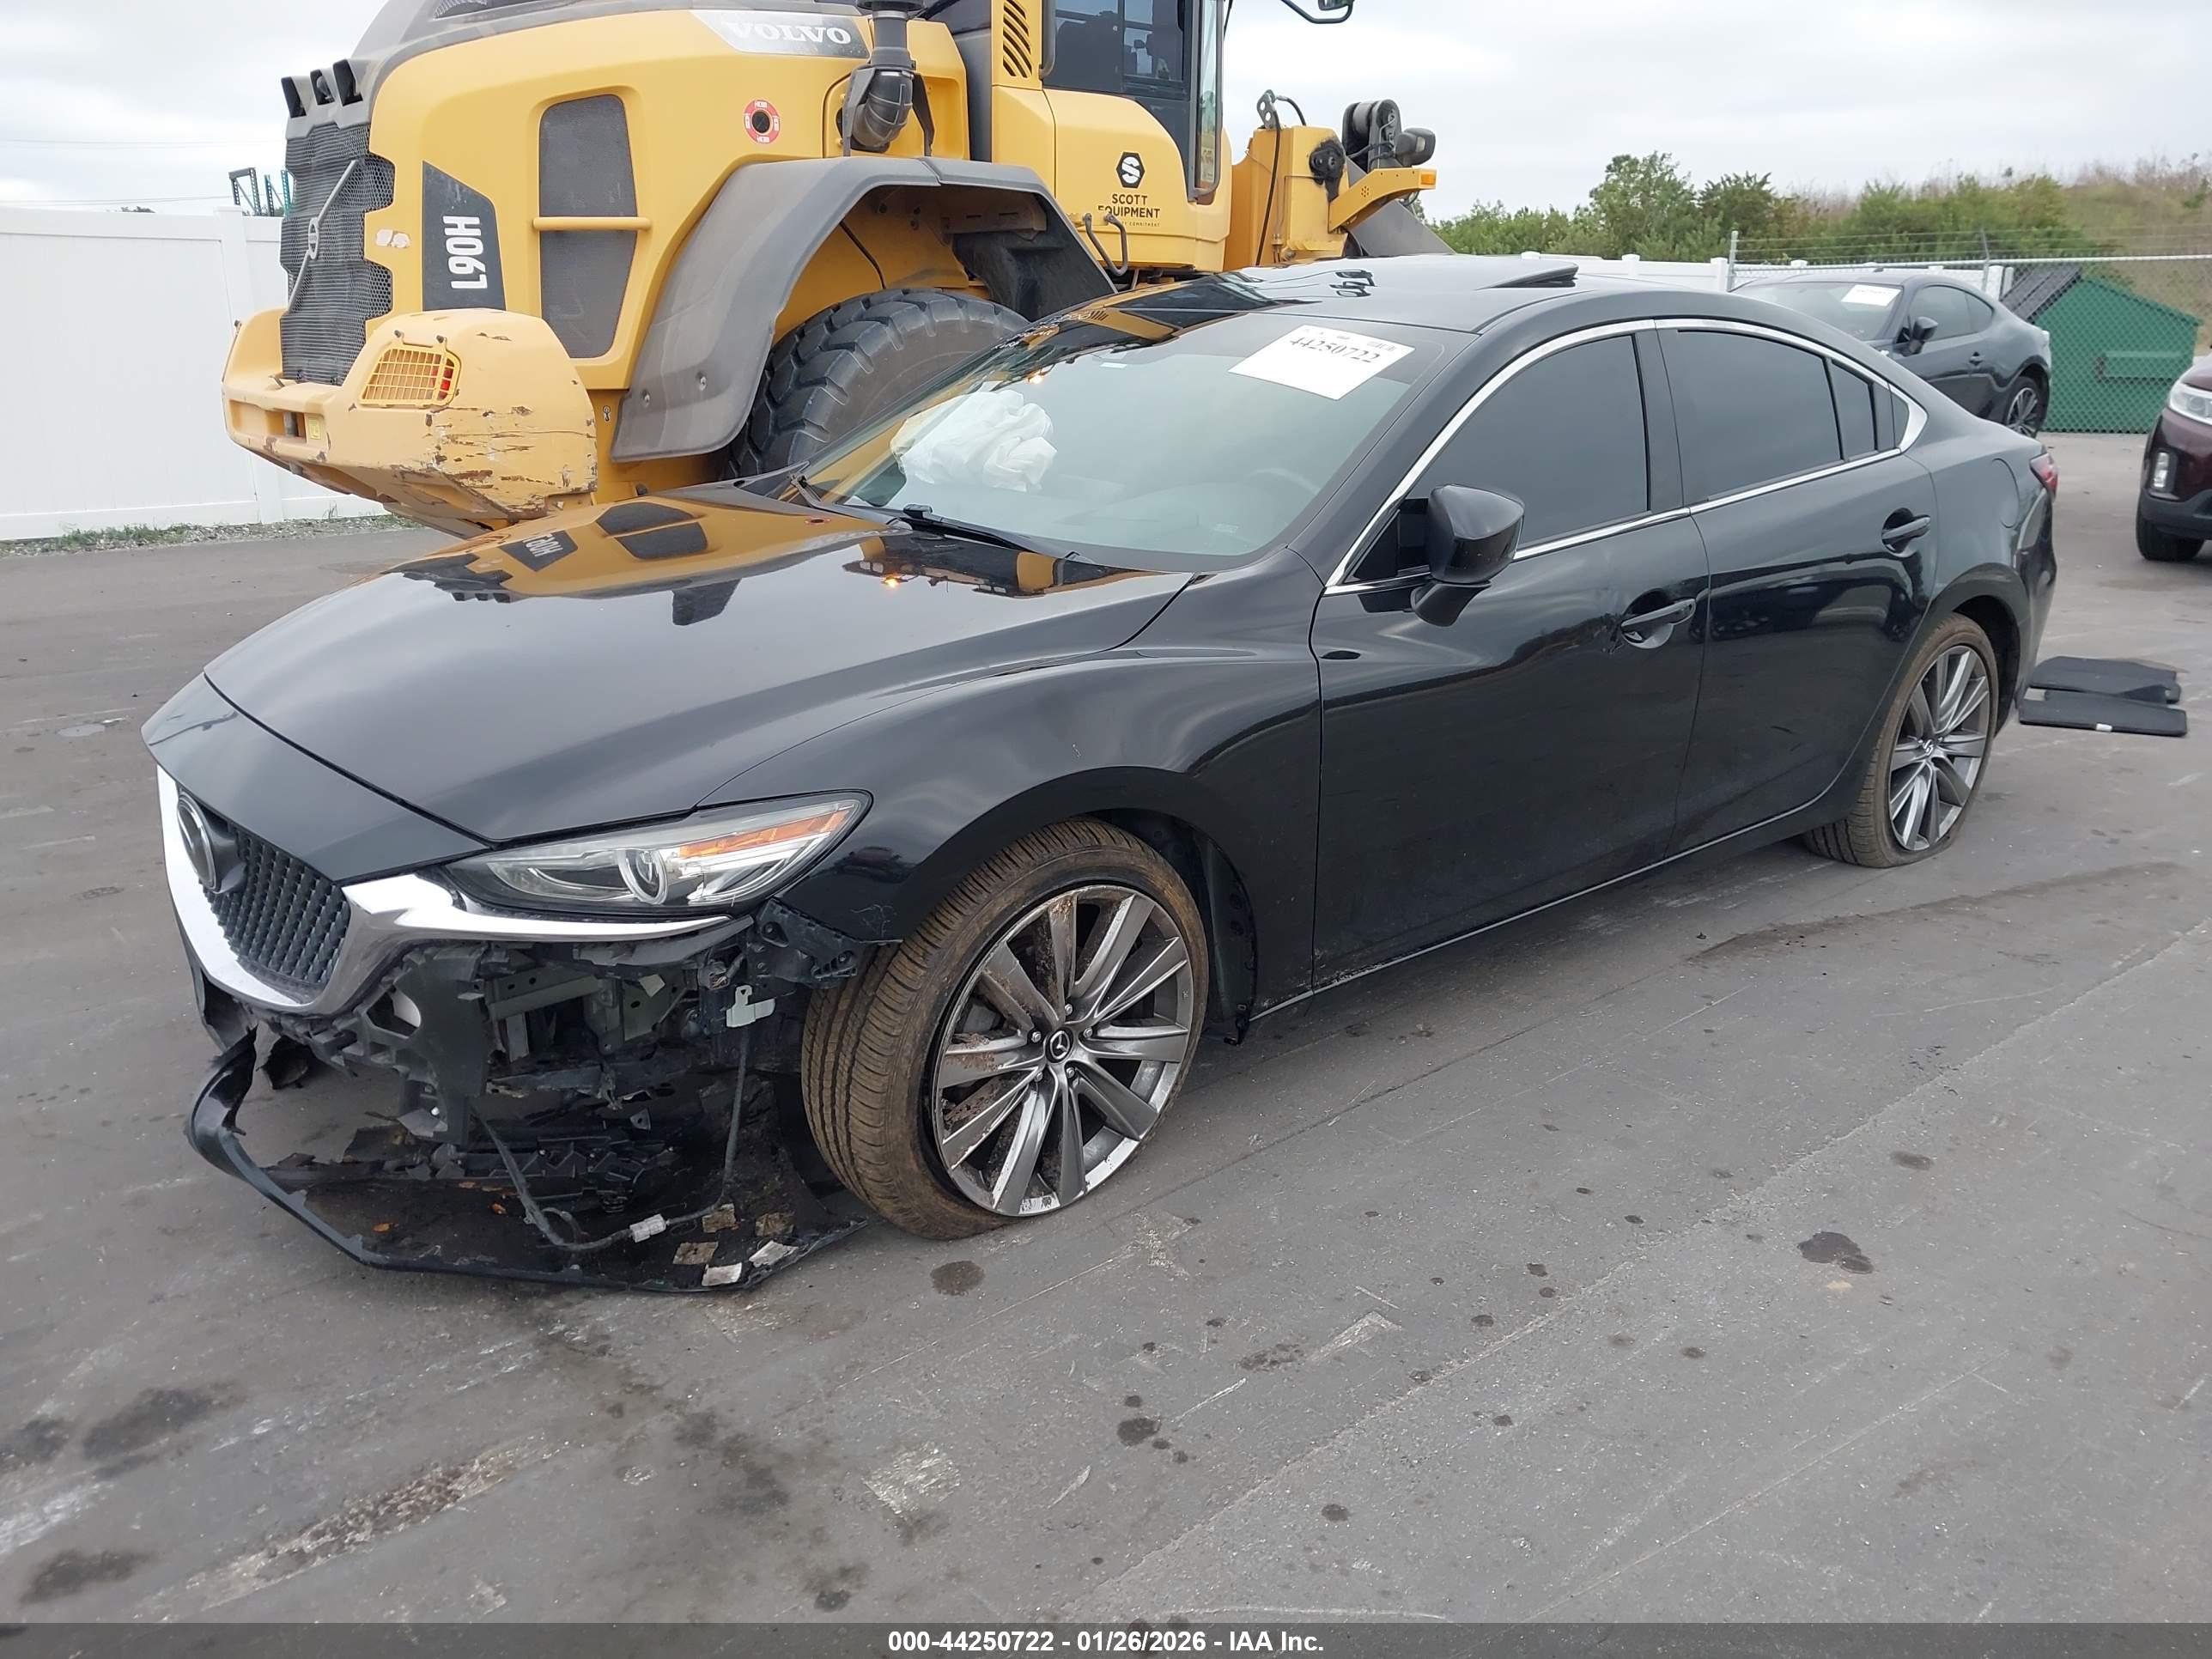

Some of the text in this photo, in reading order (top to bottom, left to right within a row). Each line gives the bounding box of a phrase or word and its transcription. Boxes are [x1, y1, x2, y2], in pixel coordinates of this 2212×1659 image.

[722, 21, 852, 45] VOLVO
[1112, 194, 1148, 205] SCOTT
[442, 215, 488, 289] L90H
[1289, 337, 1381, 363] 44250722
